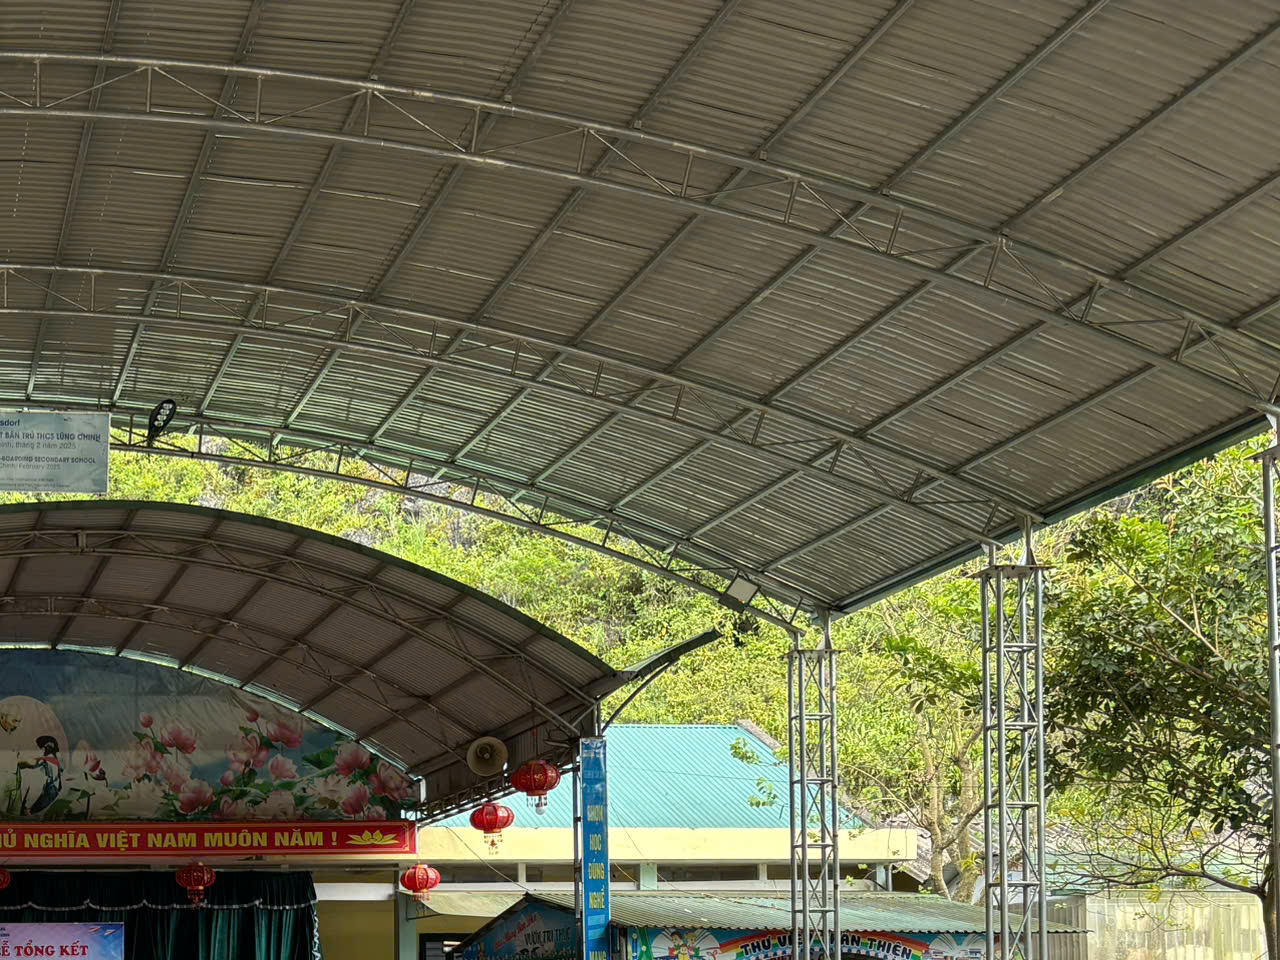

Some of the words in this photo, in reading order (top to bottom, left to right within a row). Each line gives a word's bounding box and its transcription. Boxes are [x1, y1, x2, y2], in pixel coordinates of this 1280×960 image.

[24, 830, 90, 848] NGHĨA
[96, 830, 141, 852] VIỆT
[147, 832, 197, 848] NAM
[204, 830, 267, 847] MUÔN
[275, 828, 323, 847] NĂM
[589, 833, 602, 854] HỌC
[588, 858, 605, 880] ĐÚNG
[588, 884, 606, 909] NGHỀ
[14, 940, 56, 957] TỔNG
[59, 940, 89, 956] KẾT
[739, 936, 772, 956] THƯ
